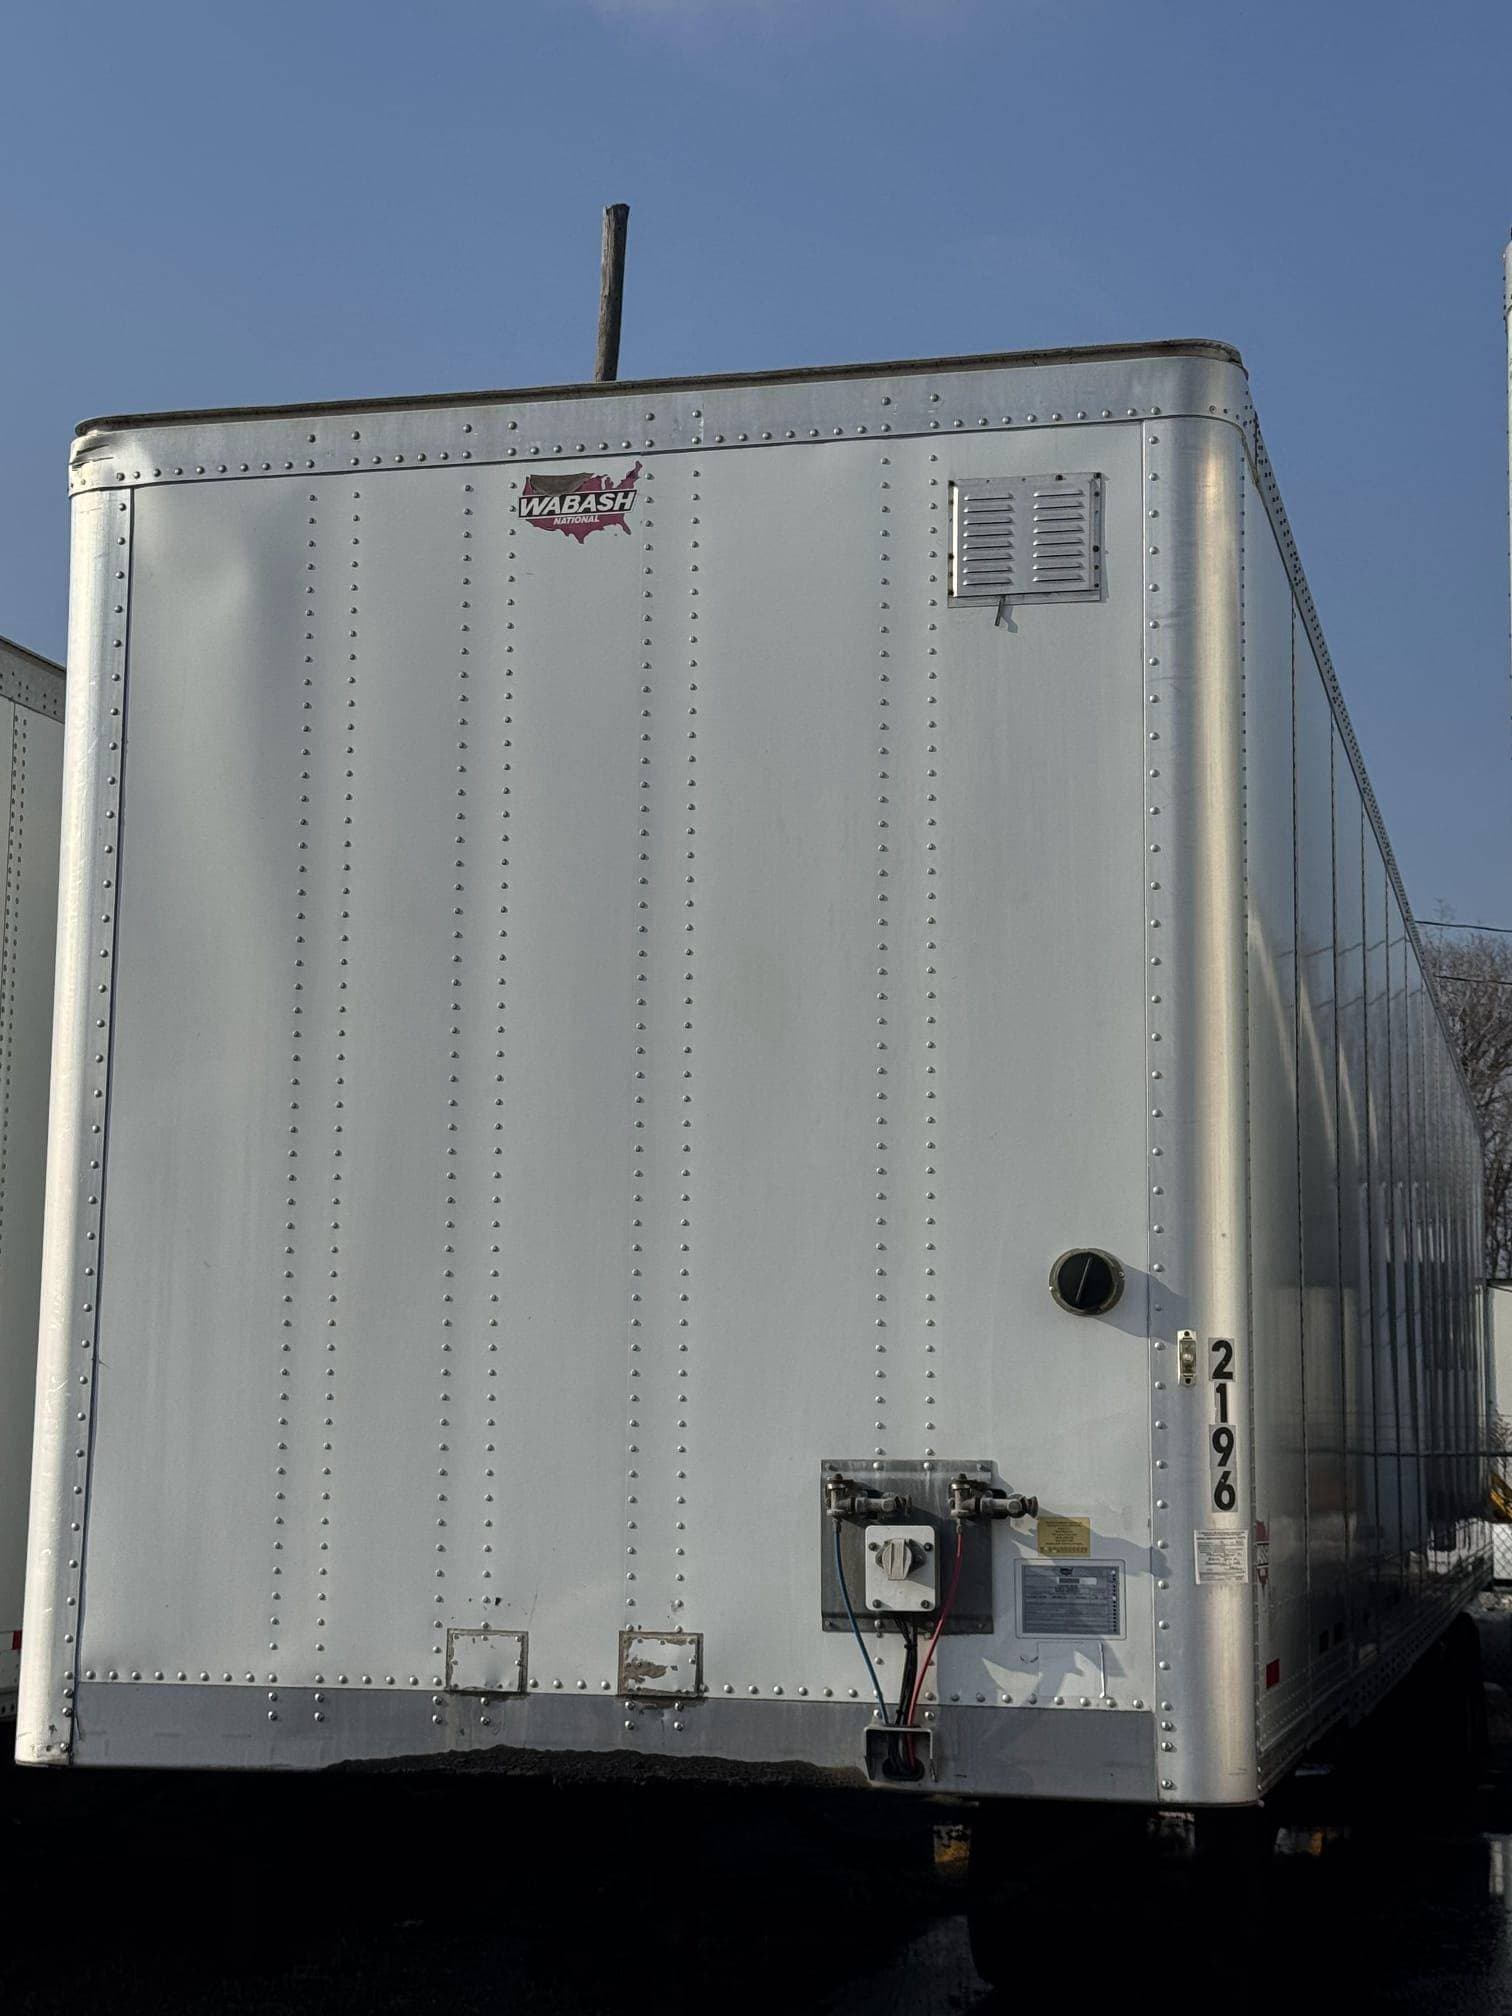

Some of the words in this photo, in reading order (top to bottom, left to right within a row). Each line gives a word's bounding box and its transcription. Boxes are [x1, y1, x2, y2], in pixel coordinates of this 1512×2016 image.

[520, 492, 632, 516] WABASH
[553, 516, 600, 525] NATIONAL
[1211, 1340, 1236, 1511] 2196
